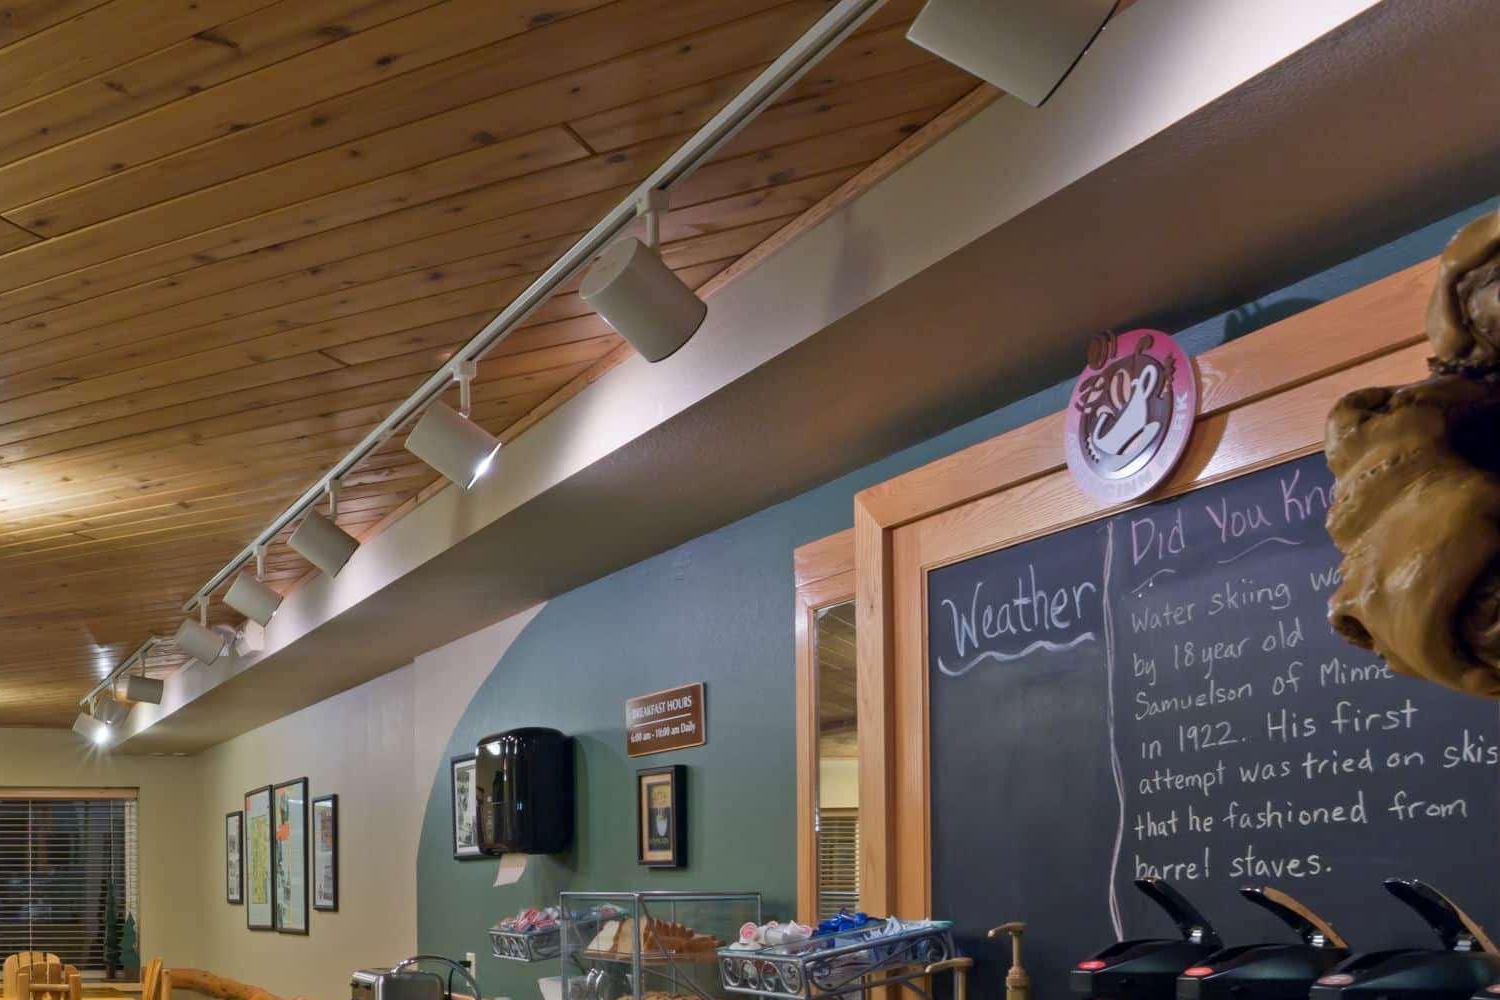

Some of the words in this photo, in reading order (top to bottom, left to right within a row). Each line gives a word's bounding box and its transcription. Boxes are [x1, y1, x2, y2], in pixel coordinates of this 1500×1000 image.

[1131, 508, 1185, 566] Did
[1205, 497, 1271, 544] You
[1281, 469, 1336, 523] Kn
[941, 565, 1096, 657] Weather
[1131, 602, 1195, 633] Water
[1208, 578, 1291, 616] skiing
[1133, 653, 1156, 686] by
[1174, 641, 1194, 670] 18
[1201, 638, 1250, 679] year
[1262, 617, 1304, 651] old
[667, 695, 692, 712] HOURS
[1135, 679, 1252, 721] Samuelson
[1272, 661, 1304, 696] of
[1320, 657, 1396, 687] Minne
[680, 720, 696, 734] Daily
[1142, 737, 1162, 759] in
[1179, 721, 1247, 752] 1922.
[1267, 709, 1316, 742] His
[1331, 699, 1419, 734] first
[1139, 760, 1226, 796] attempt
[1240, 761, 1291, 784] was
[1301, 748, 1374, 779] tried
[1387, 753, 1424, 770] on
[1443, 729, 1499, 768] skis
[1133, 810, 1178, 840] that
[1188, 806, 1213, 832] he
[1223, 790, 1369, 830] fashioned
[1388, 790, 1467, 822] from
[1135, 847, 1210, 881] barrel
[1229, 845, 1333, 878] staves.
